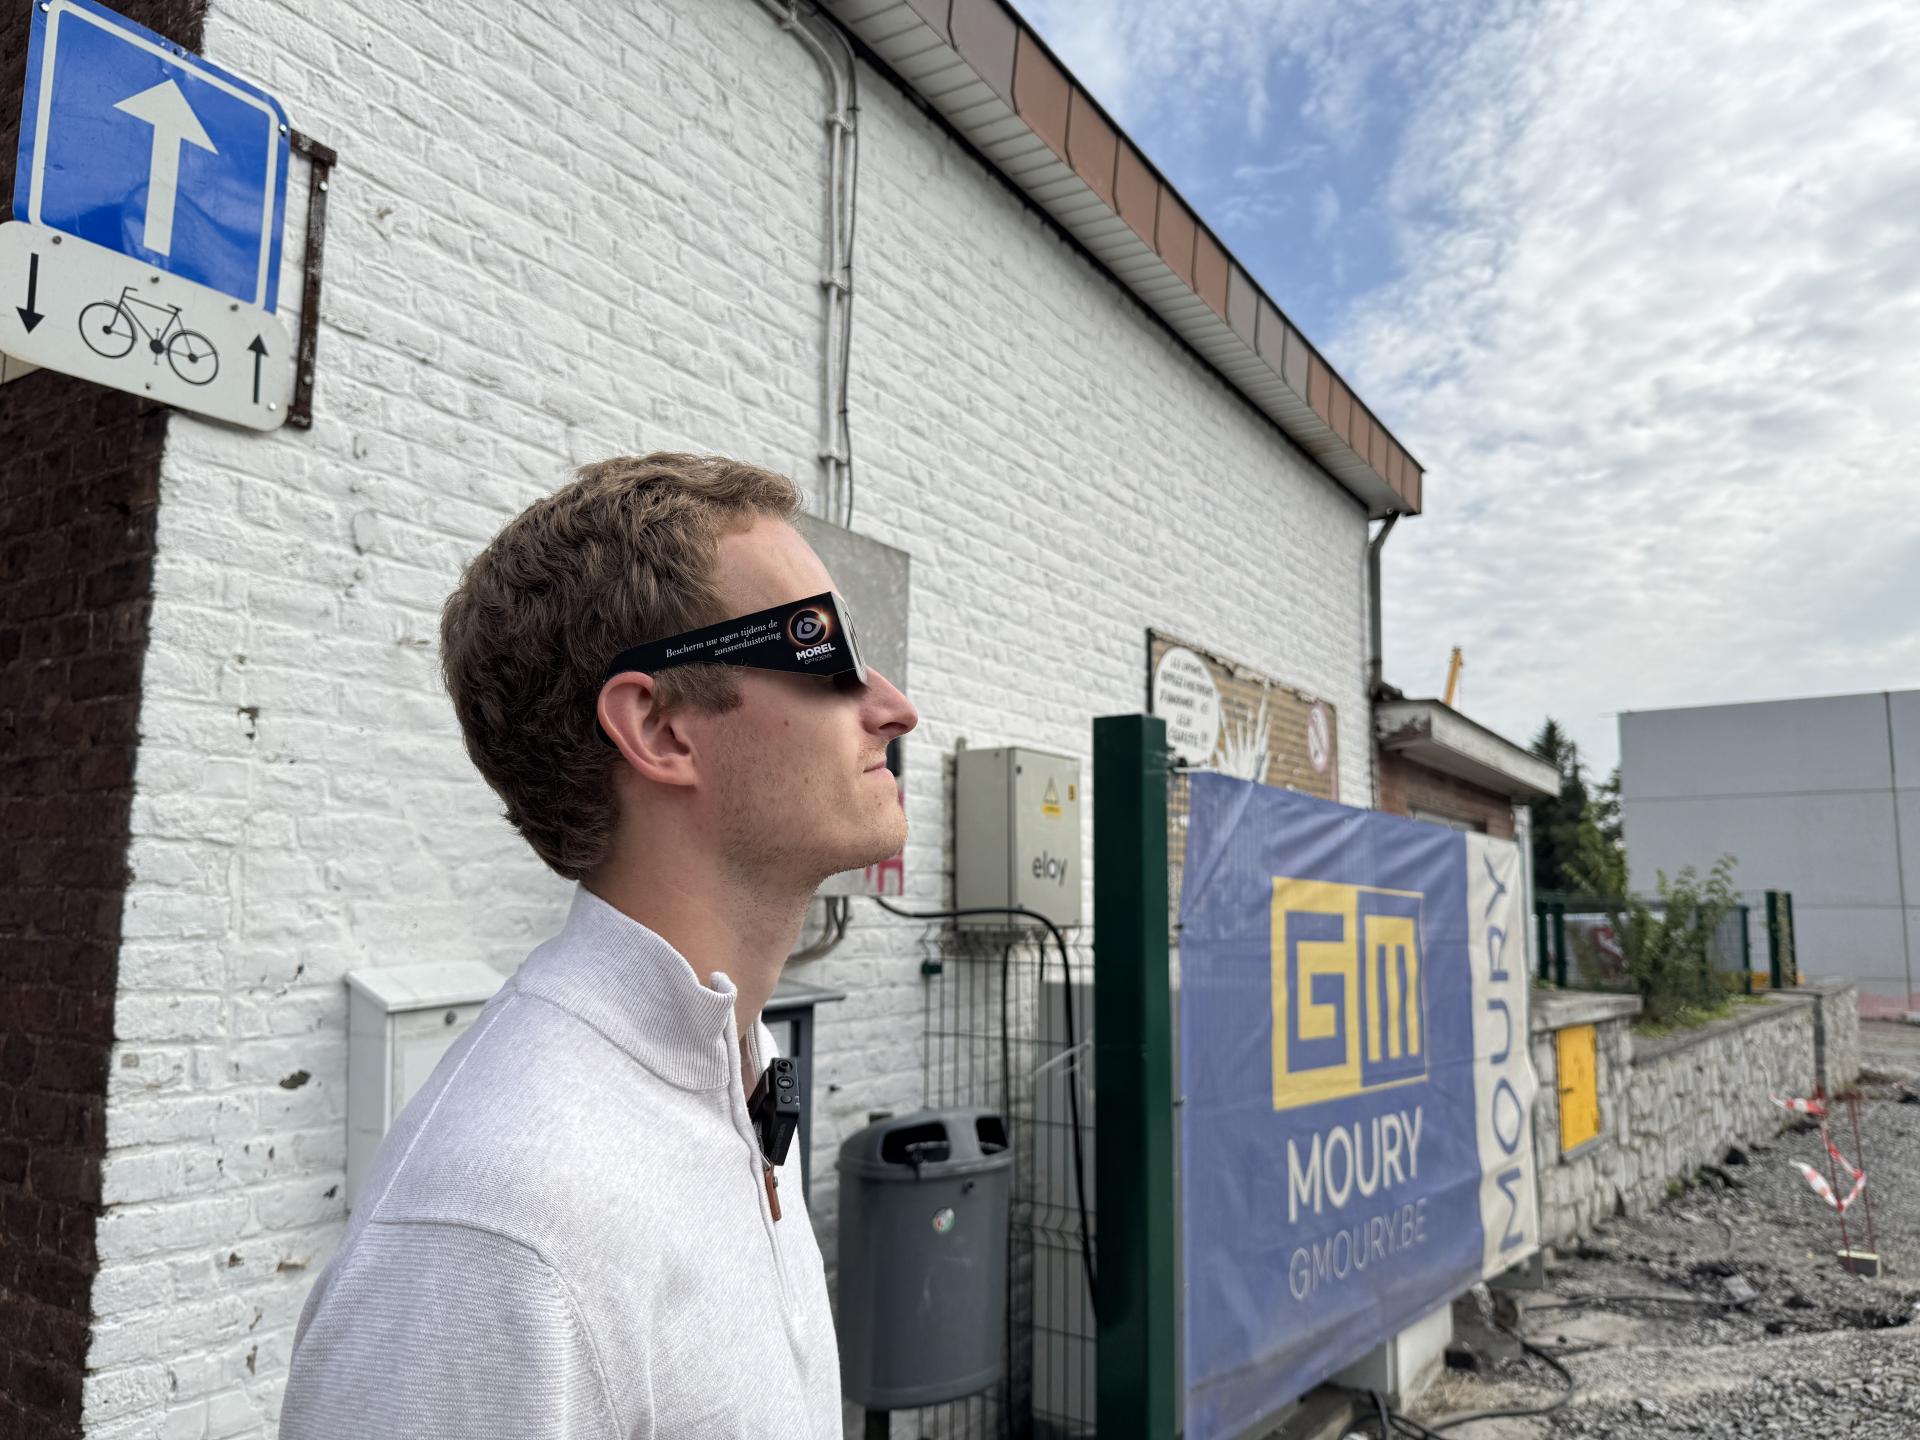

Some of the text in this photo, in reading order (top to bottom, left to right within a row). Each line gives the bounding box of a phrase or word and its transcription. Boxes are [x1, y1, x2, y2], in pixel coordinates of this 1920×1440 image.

[666, 619, 778, 658] Bescherm uw ogen tijdens de
[714, 631, 782, 657] zonsverduistering
[796, 642, 836, 661] MOREL
[1032, 851, 1068, 887] eloy
[1484, 854, 1524, 1256] MOURY
[1287, 1106, 1423, 1225] MOURY
[1288, 1197, 1428, 1301] GMOURY.BE
